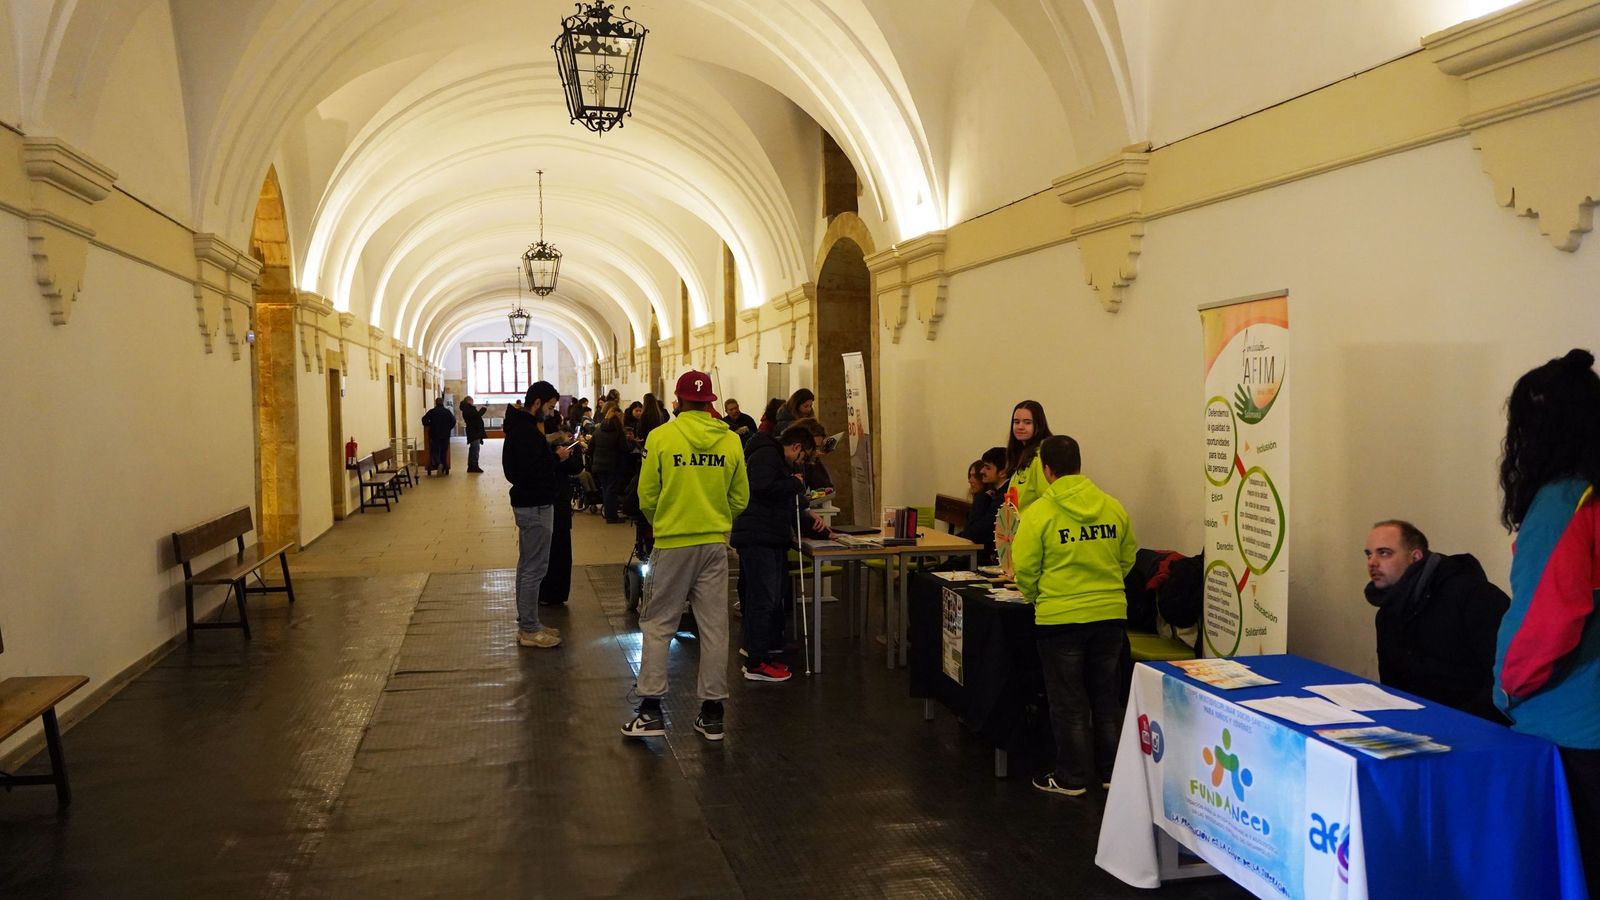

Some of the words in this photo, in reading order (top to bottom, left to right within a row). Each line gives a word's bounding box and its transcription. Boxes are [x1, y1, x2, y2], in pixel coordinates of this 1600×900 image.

[1243, 356, 1275, 384] AFIM
[694, 379, 704, 392] P
[1256, 441, 1277, 454] Inclusión
[673, 454, 686, 467] F.
[689, 453, 725, 467] AFIM
[1058, 529, 1075, 544] F.
[1079, 524, 1117, 541] AFIM
[1216, 541, 1234, 551] Derecho
[1253, 599, 1278, 623] Educación
[1245, 625, 1267, 637] Solidaridad
